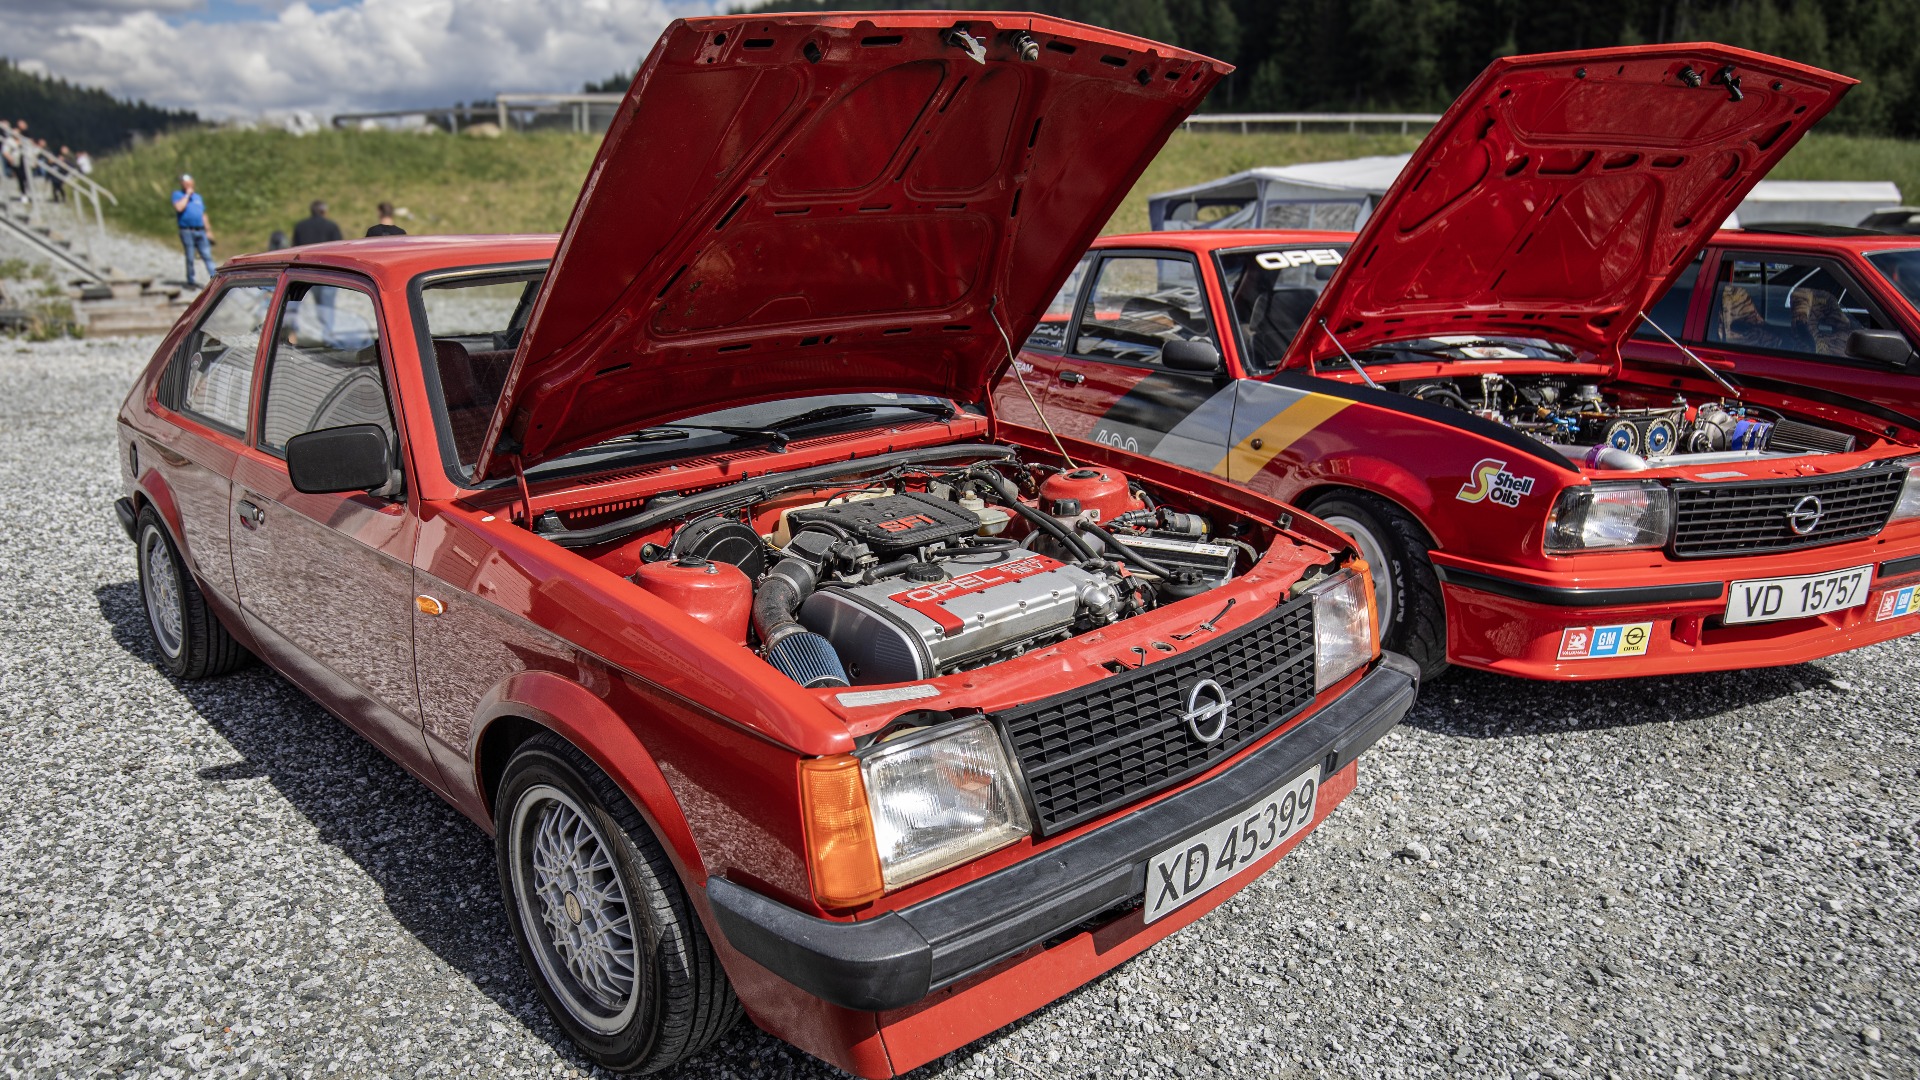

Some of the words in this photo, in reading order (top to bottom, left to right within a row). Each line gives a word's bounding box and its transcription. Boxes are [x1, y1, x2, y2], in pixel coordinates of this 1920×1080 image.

[1096, 429, 1138, 453] 400
[1494, 472, 1533, 494] Shell
[1490, 487, 1519, 506] Oils
[1011, 560, 1044, 575] 16V
[906, 574, 1005, 603] OPEL
[1392, 560, 1405, 623] AVON
[1745, 584, 1783, 617] VD
[1800, 572, 1863, 613] 15757
[1598, 631, 1617, 646] GM
[1153, 842, 1210, 912] XD
[1214, 778, 1315, 872] 45399
